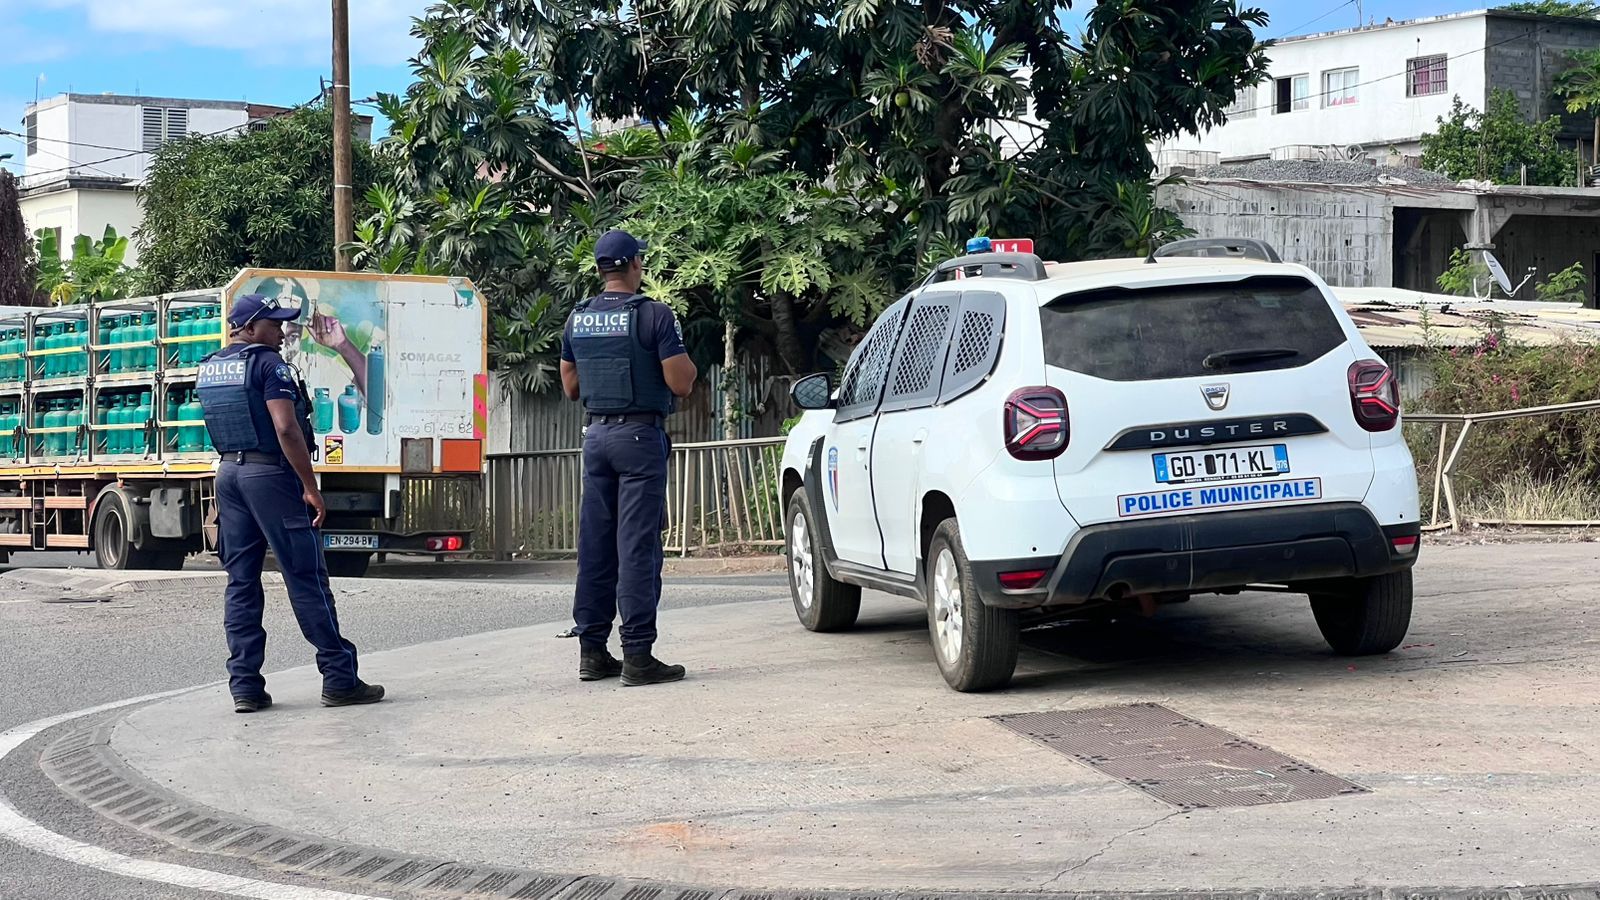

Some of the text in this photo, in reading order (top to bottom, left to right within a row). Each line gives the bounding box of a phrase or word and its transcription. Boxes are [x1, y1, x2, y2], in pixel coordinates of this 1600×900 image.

[995, 243, 1018, 253] N 1
[574, 313, 628, 327] POLICE
[400, 352, 462, 362] SOMAGAZ
[198, 361, 245, 377] POLICE
[424, 421, 436, 434] 61
[439, 422, 455, 434] 45
[1150, 420, 1288, 441] DUSTER
[1125, 481, 1315, 512] POLICE MUNICIPALE
